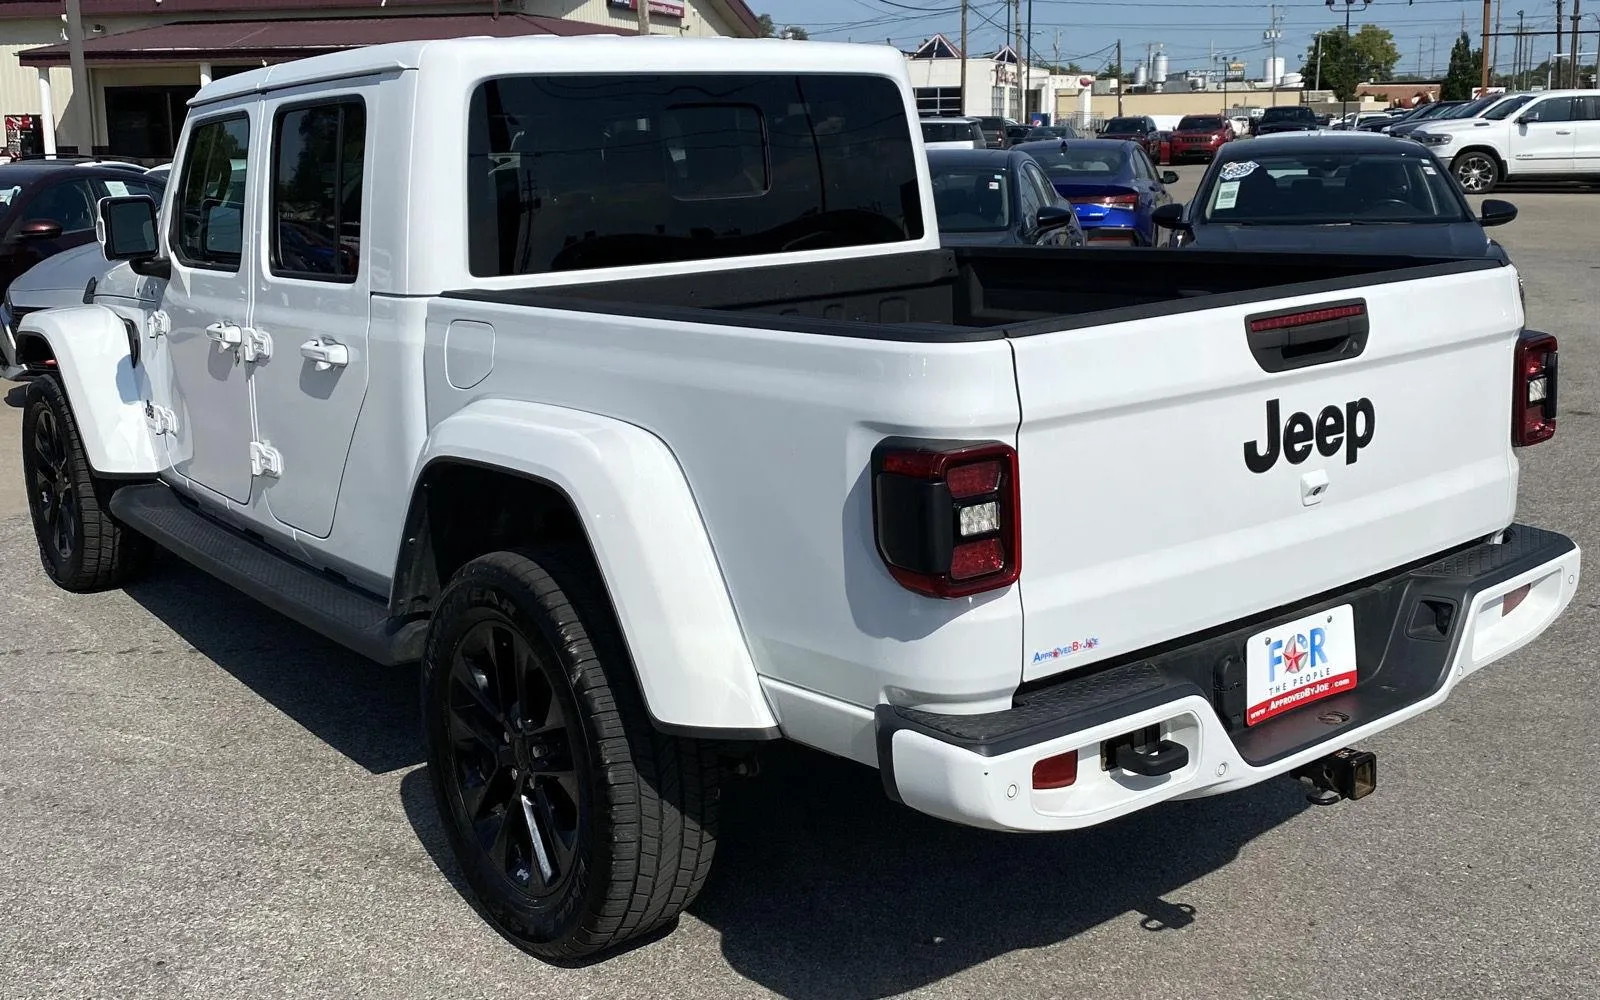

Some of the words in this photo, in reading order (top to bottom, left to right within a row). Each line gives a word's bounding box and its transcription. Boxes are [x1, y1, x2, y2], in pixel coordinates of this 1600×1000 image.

[1244, 397, 1375, 473] Jeep
[1268, 627, 1328, 682] FOR
[1269, 682, 1287, 696] THE
[1293, 667, 1330, 687] PEOPLE
